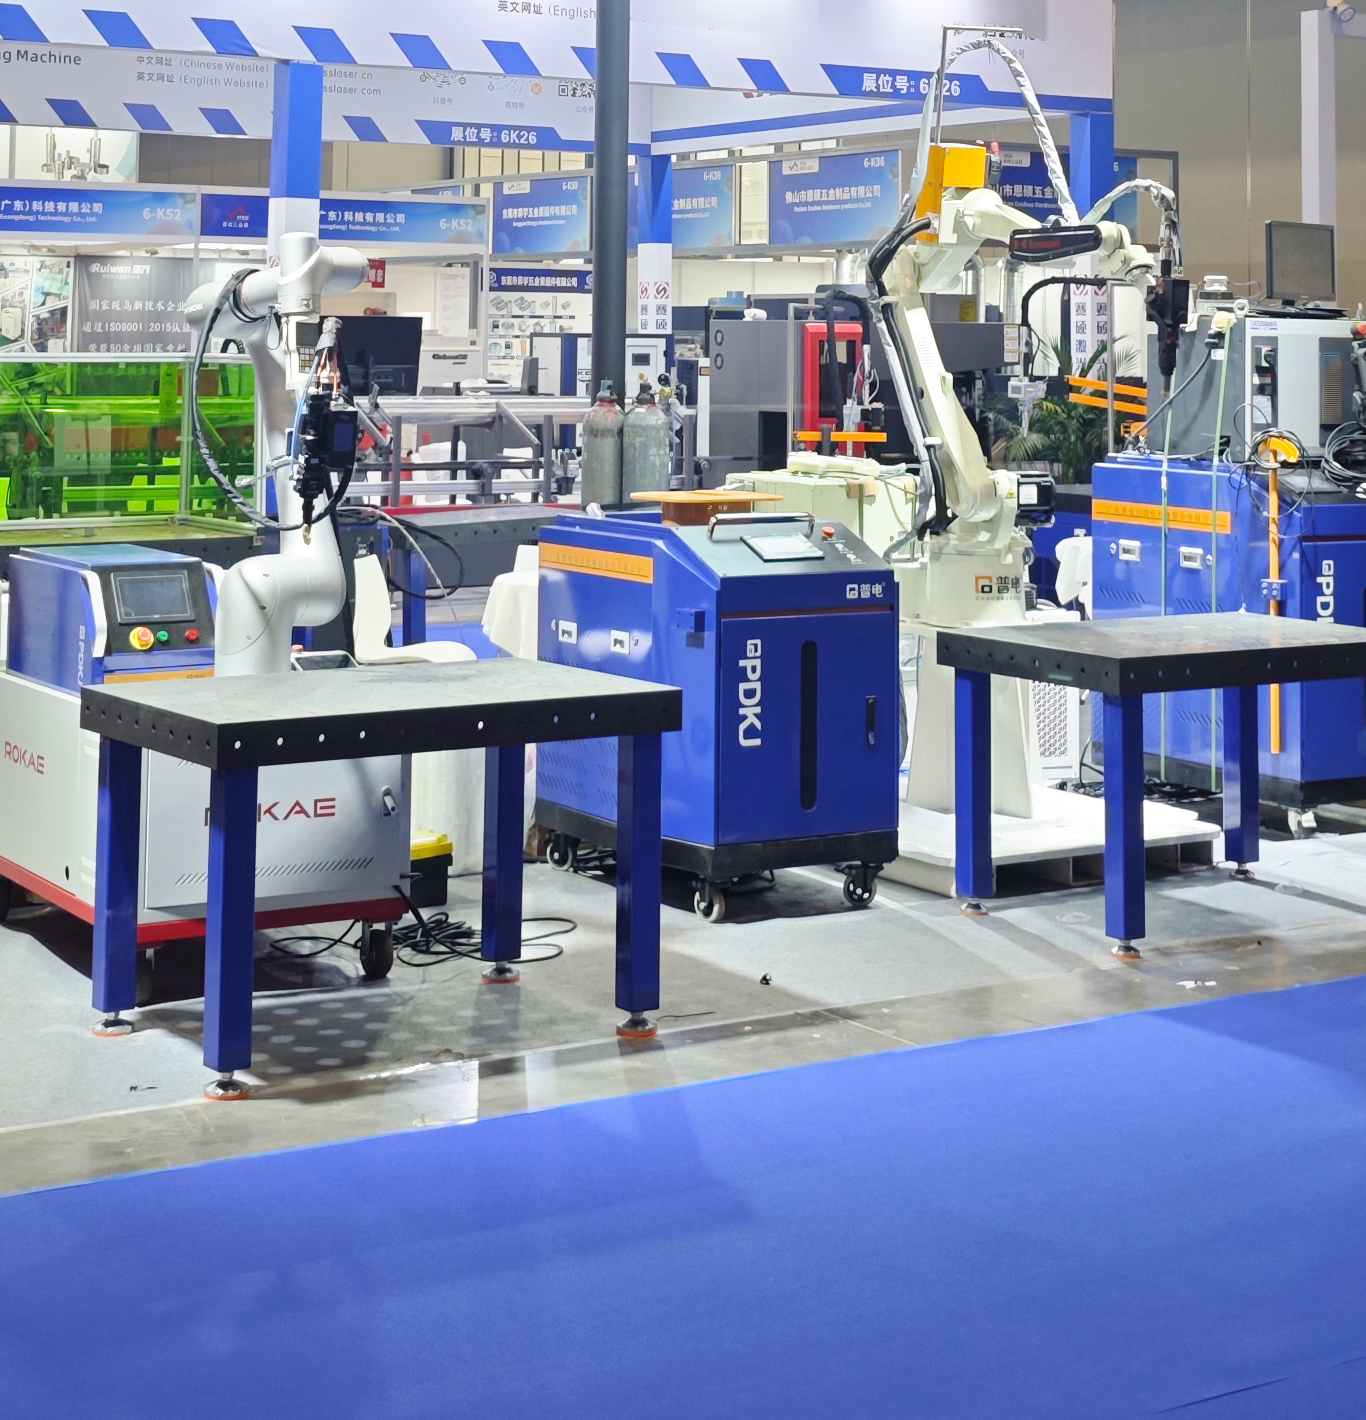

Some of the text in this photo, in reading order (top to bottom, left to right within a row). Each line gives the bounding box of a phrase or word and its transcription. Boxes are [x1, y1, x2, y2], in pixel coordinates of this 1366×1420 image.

[498, 0, 543, 15] 英文网址
[16, 49, 82, 65] Machine
[136, 55, 174, 67] 中文网址
[136, 72, 175, 85] 英文网址
[996, 184, 1059, 199] 山市恩硕五金
[143, 208, 182, 221] 6-K52
[440, 218, 473, 230] 6-K52
[1316, 576, 1334, 623] PD
[738, 657, 761, 747] PDKJ
[4, 741, 45, 775] ROKAE
[204, 797, 336, 827] KAE
